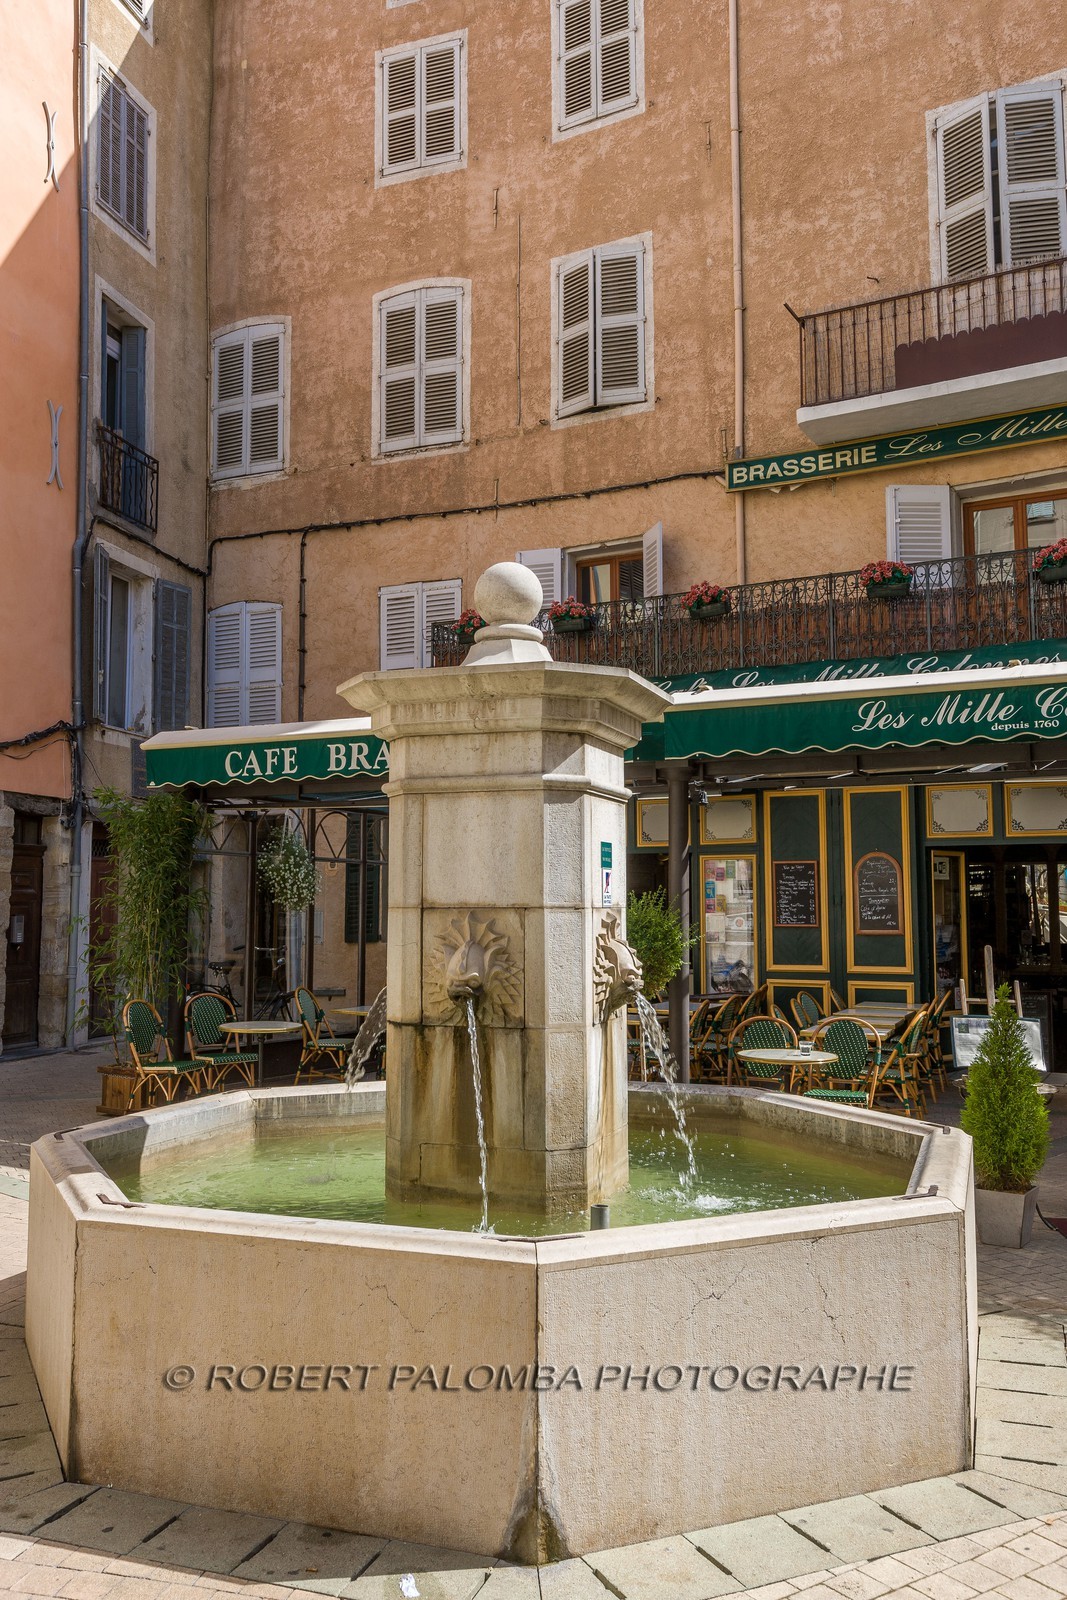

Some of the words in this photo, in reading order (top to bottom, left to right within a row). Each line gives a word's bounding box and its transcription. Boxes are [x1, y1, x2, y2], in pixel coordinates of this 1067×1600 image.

[733, 445, 877, 485] BRASSERIE
[884, 434, 944, 459] Les
[957, 412, 1067, 446] Mille
[852, 700, 914, 732] Les
[921, 692, 1023, 727] Mille
[1035, 687, 1067, 719] C
[991, 721, 1030, 732] depuis
[1034, 719, 1060, 729] 1760
[224, 746, 298, 778] CAFE
